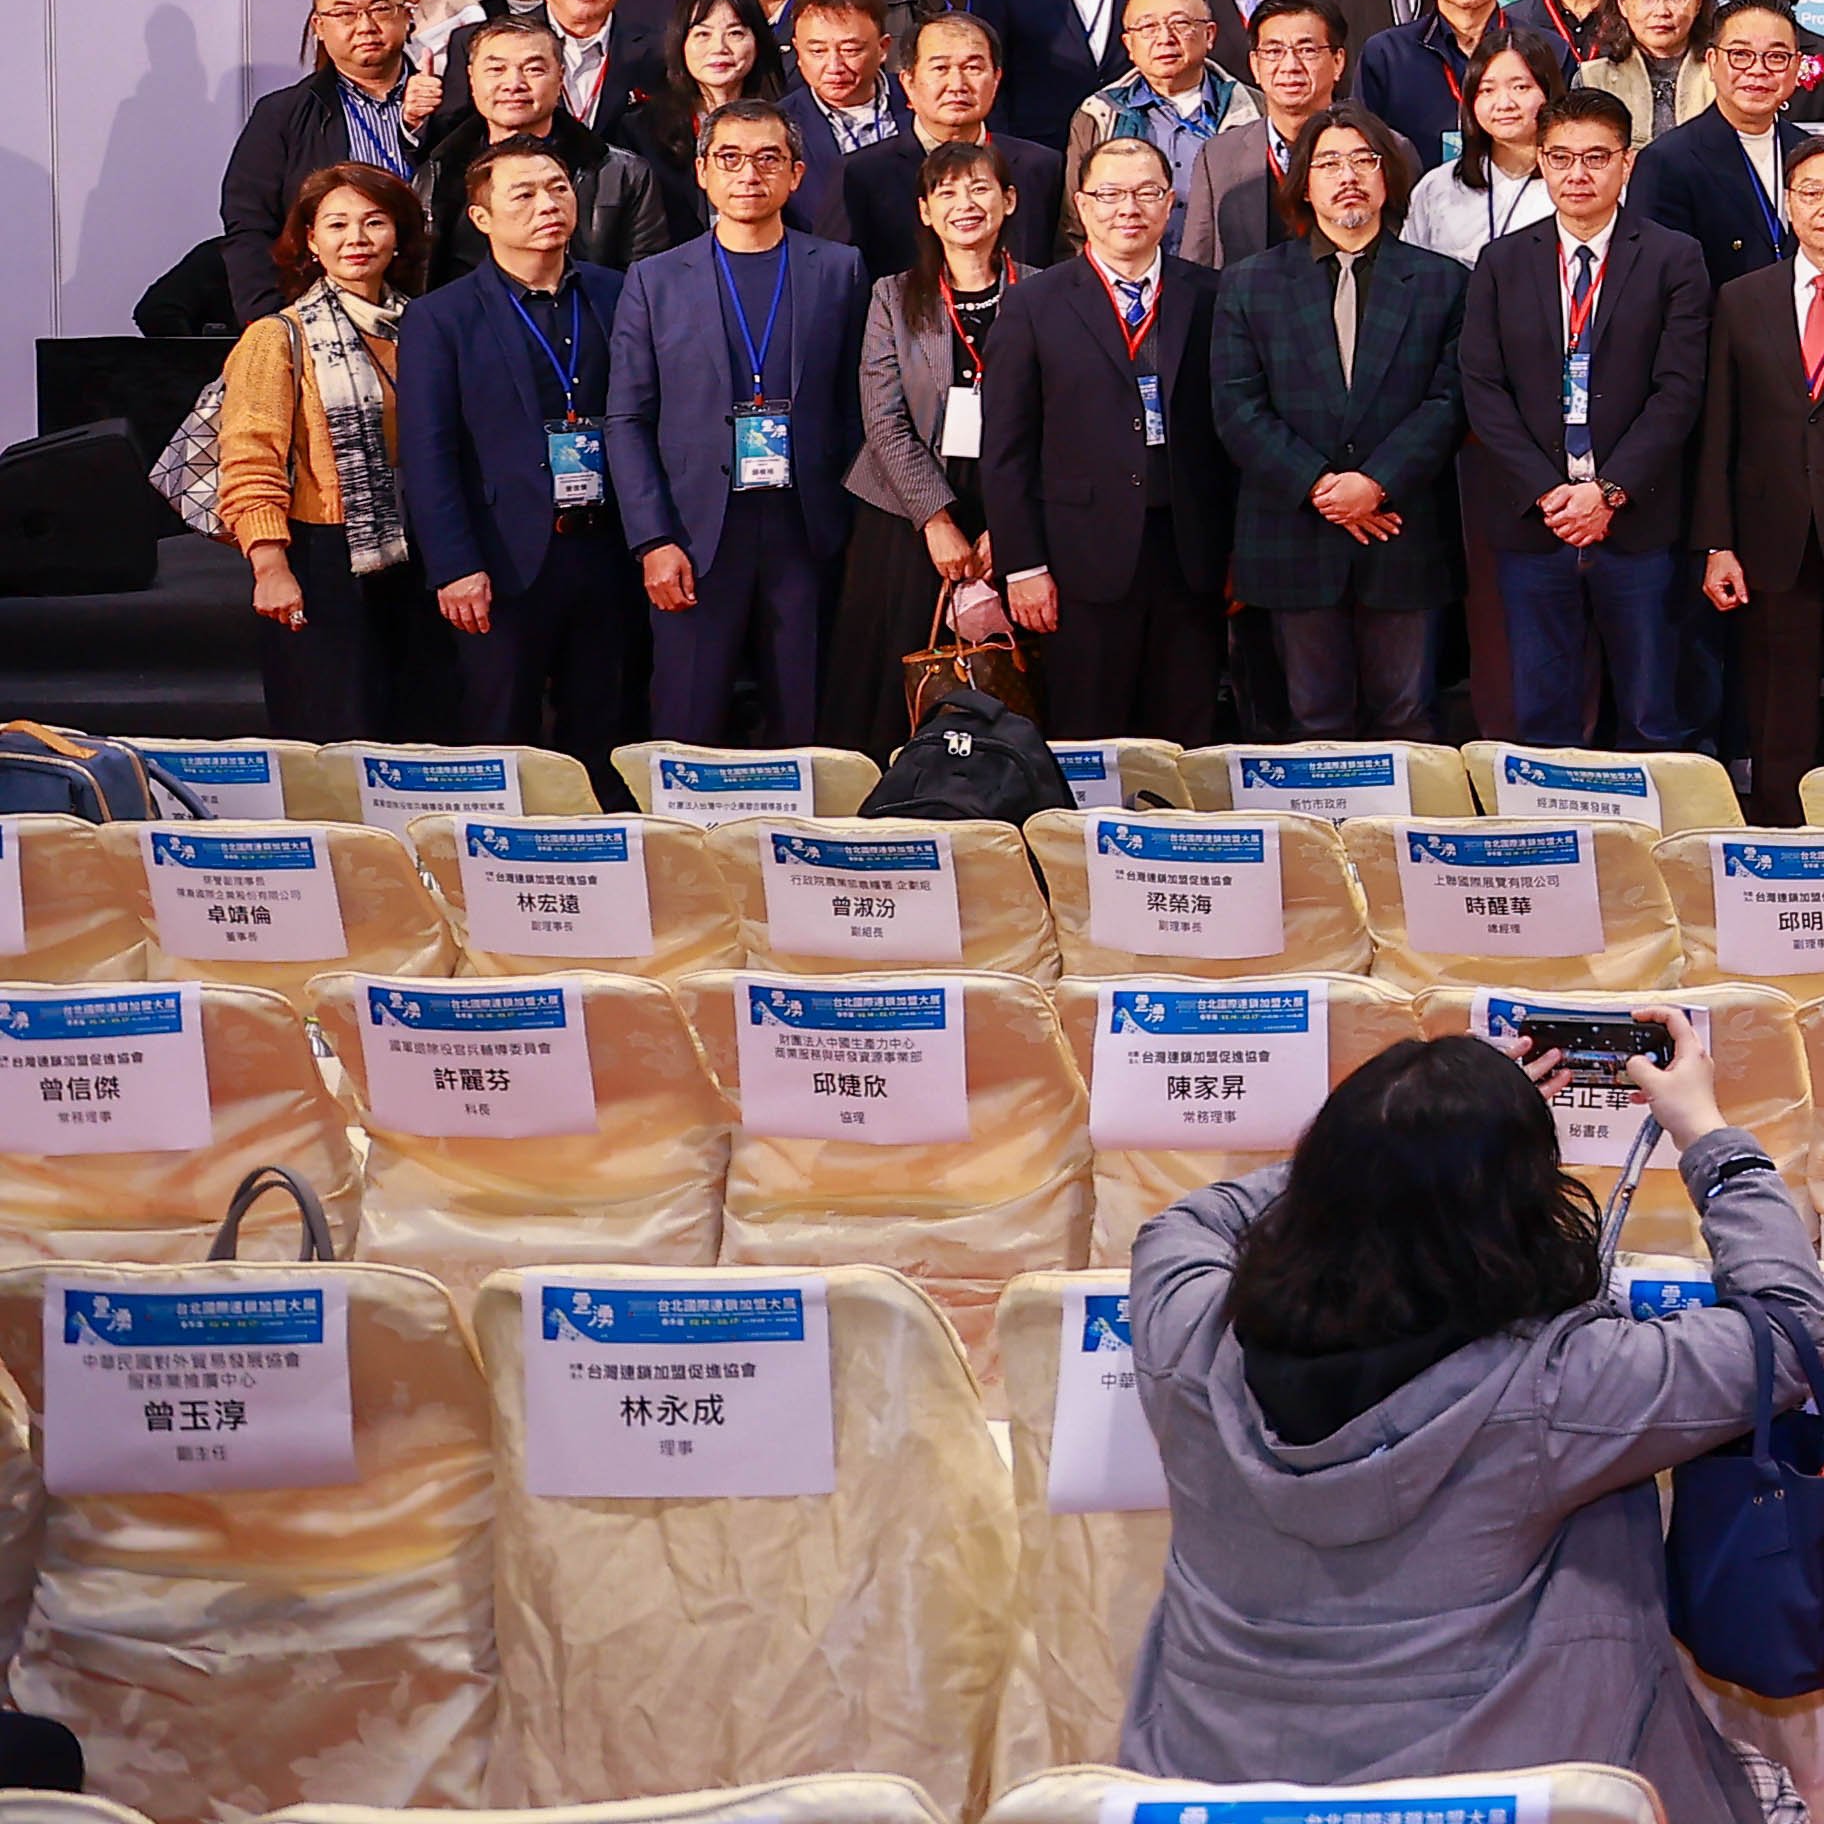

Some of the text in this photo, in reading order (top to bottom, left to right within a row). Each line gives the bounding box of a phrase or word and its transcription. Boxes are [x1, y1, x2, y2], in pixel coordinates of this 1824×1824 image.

[1290, 798, 1346, 810] 新竹市政府
[1537, 797, 1621, 815] 經濟部商業發展署
[1434, 874, 1559, 888] 上聯國際展覽有限公司
[517, 893, 580, 914] 林宏遠
[832, 897, 896, 918] 曾淑汾
[1147, 892, 1212, 914] 梁榮海
[1466, 896, 1532, 915] 時醒華
[208, 905, 271, 925] 卓靖倫
[779, 1034, 915, 1049] 財團法人中國生產力中心
[1142, 1050, 1270, 1064] 台灣連鎖加盟促進協會
[40, 1076, 120, 1101] 曾信傑
[434, 1068, 510, 1091] 許麗芬
[813, 1072, 887, 1098] 邱婕欣
[1168, 1076, 1246, 1100] 陳家昇
[465, 1104, 490, 1115] 科長
[840, 1112, 865, 1124] 協理
[1184, 1110, 1236, 1124] 常務理事
[1569, 1124, 1609, 1139] 秘書長
[588, 1362, 756, 1380] 台灣連鎖加盟促進協會
[144, 1400, 248, 1431] 曾玉淳
[621, 1394, 725, 1426] 林永成
[660, 1440, 693, 1456] 理事
